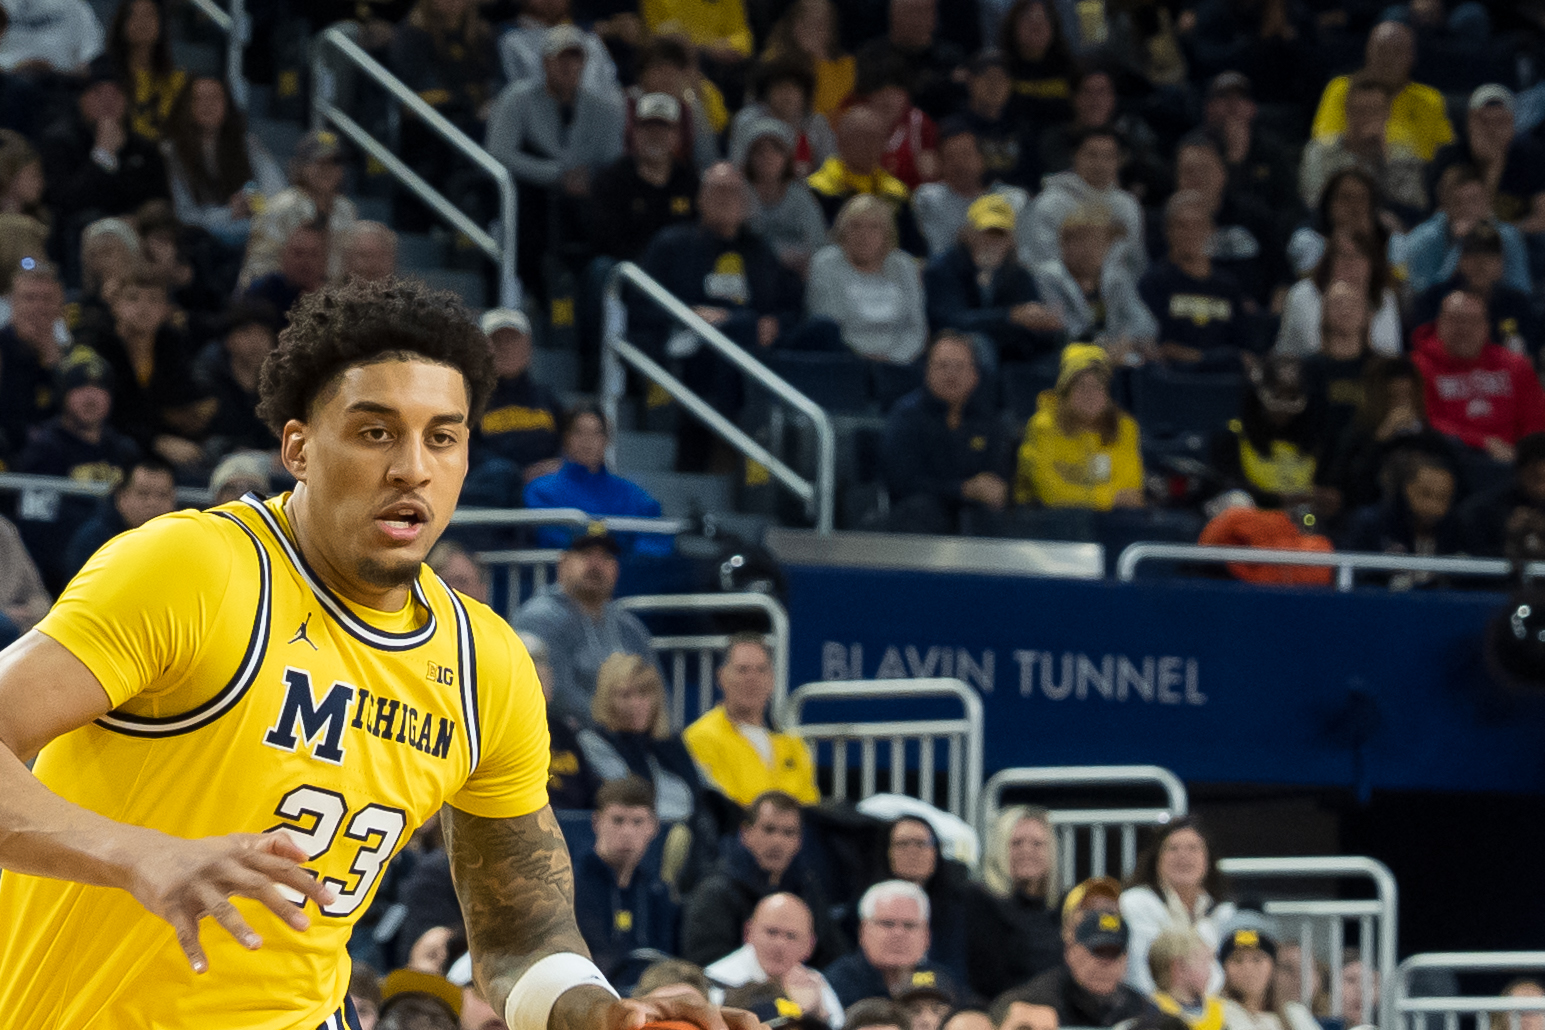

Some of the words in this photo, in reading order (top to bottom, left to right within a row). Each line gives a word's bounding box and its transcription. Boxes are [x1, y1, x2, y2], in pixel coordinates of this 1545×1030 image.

[262, 665, 456, 767] MICHIGAN
[822, 640, 996, 695] BLAVIN
[1013, 649, 1208, 706] TUNNEL
[261, 783, 408, 918] 23
